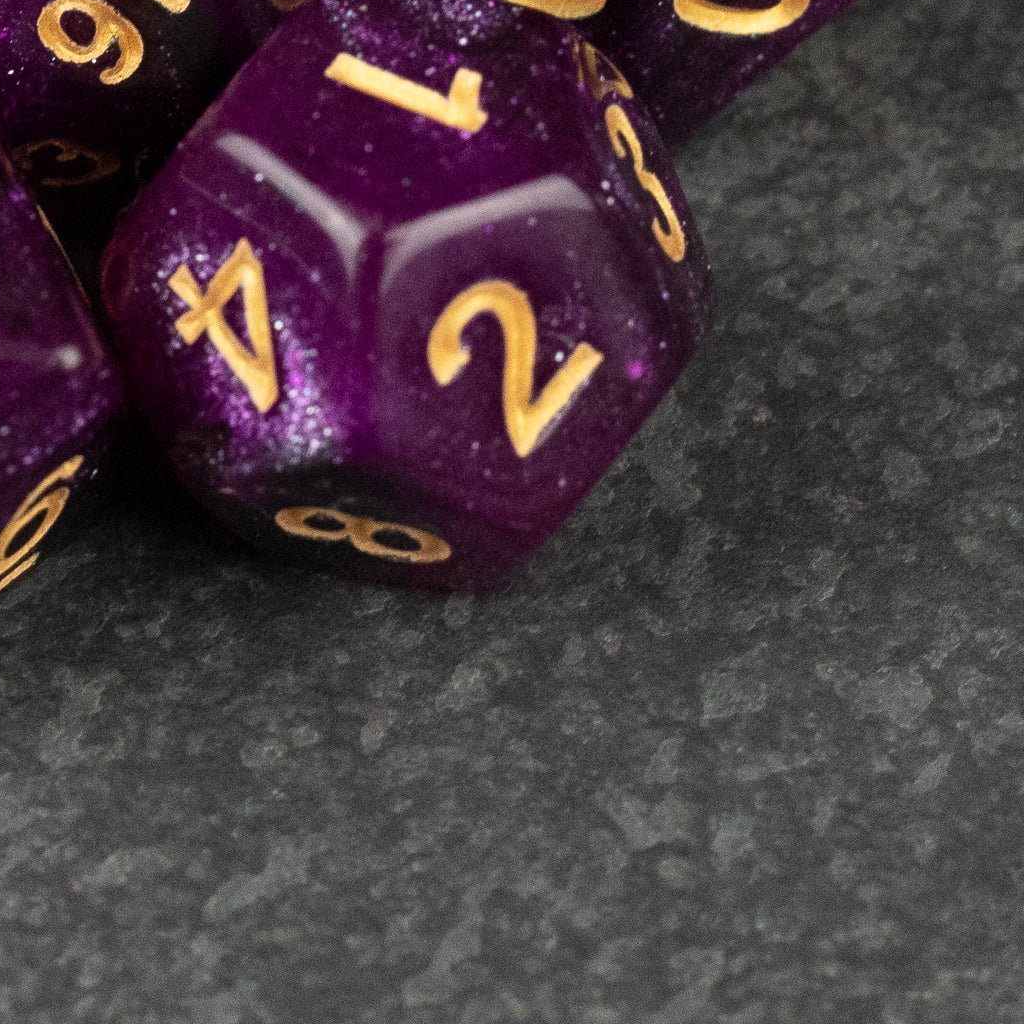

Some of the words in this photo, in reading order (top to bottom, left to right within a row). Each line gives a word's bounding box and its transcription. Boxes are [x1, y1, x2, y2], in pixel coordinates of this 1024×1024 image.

[326, 53, 487, 132] 1
[605, 104, 686, 263] 3
[169, 239, 278, 412] 4
[428, 281, 604, 458] 2
[274, 506, 452, 564] 8
